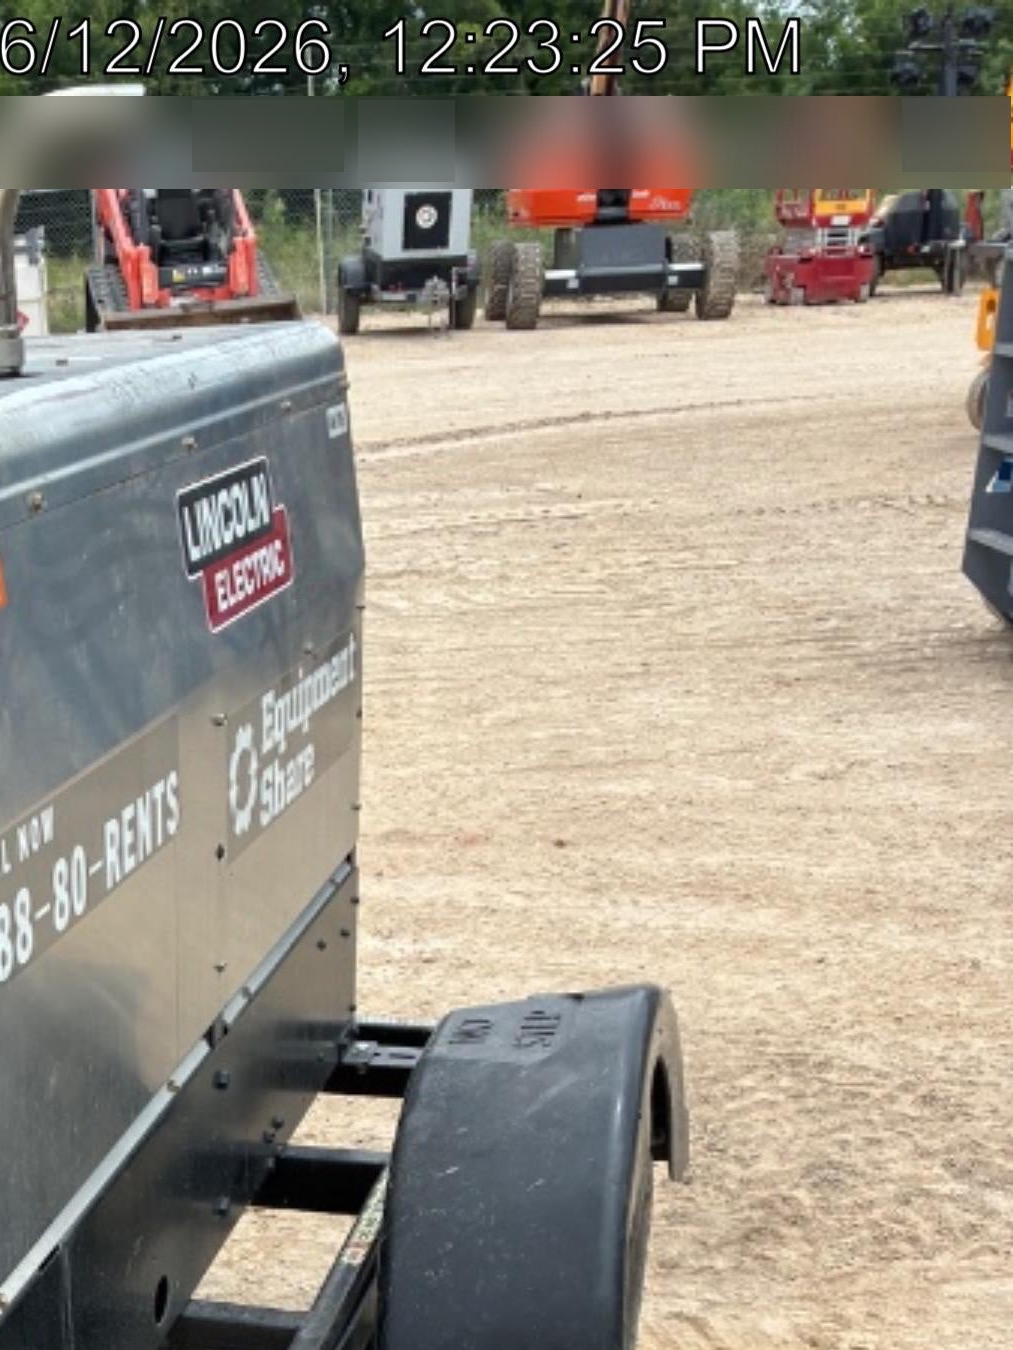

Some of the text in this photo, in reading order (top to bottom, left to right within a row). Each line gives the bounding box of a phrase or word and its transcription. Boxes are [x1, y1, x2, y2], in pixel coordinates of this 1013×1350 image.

[182, 475, 271, 561] LINCOLN
[213, 539, 285, 613] ELECTRIC
[260, 632, 357, 755] Equipment
[259, 742, 316, 827] Share
[17, 804, 55, 863] NOW
